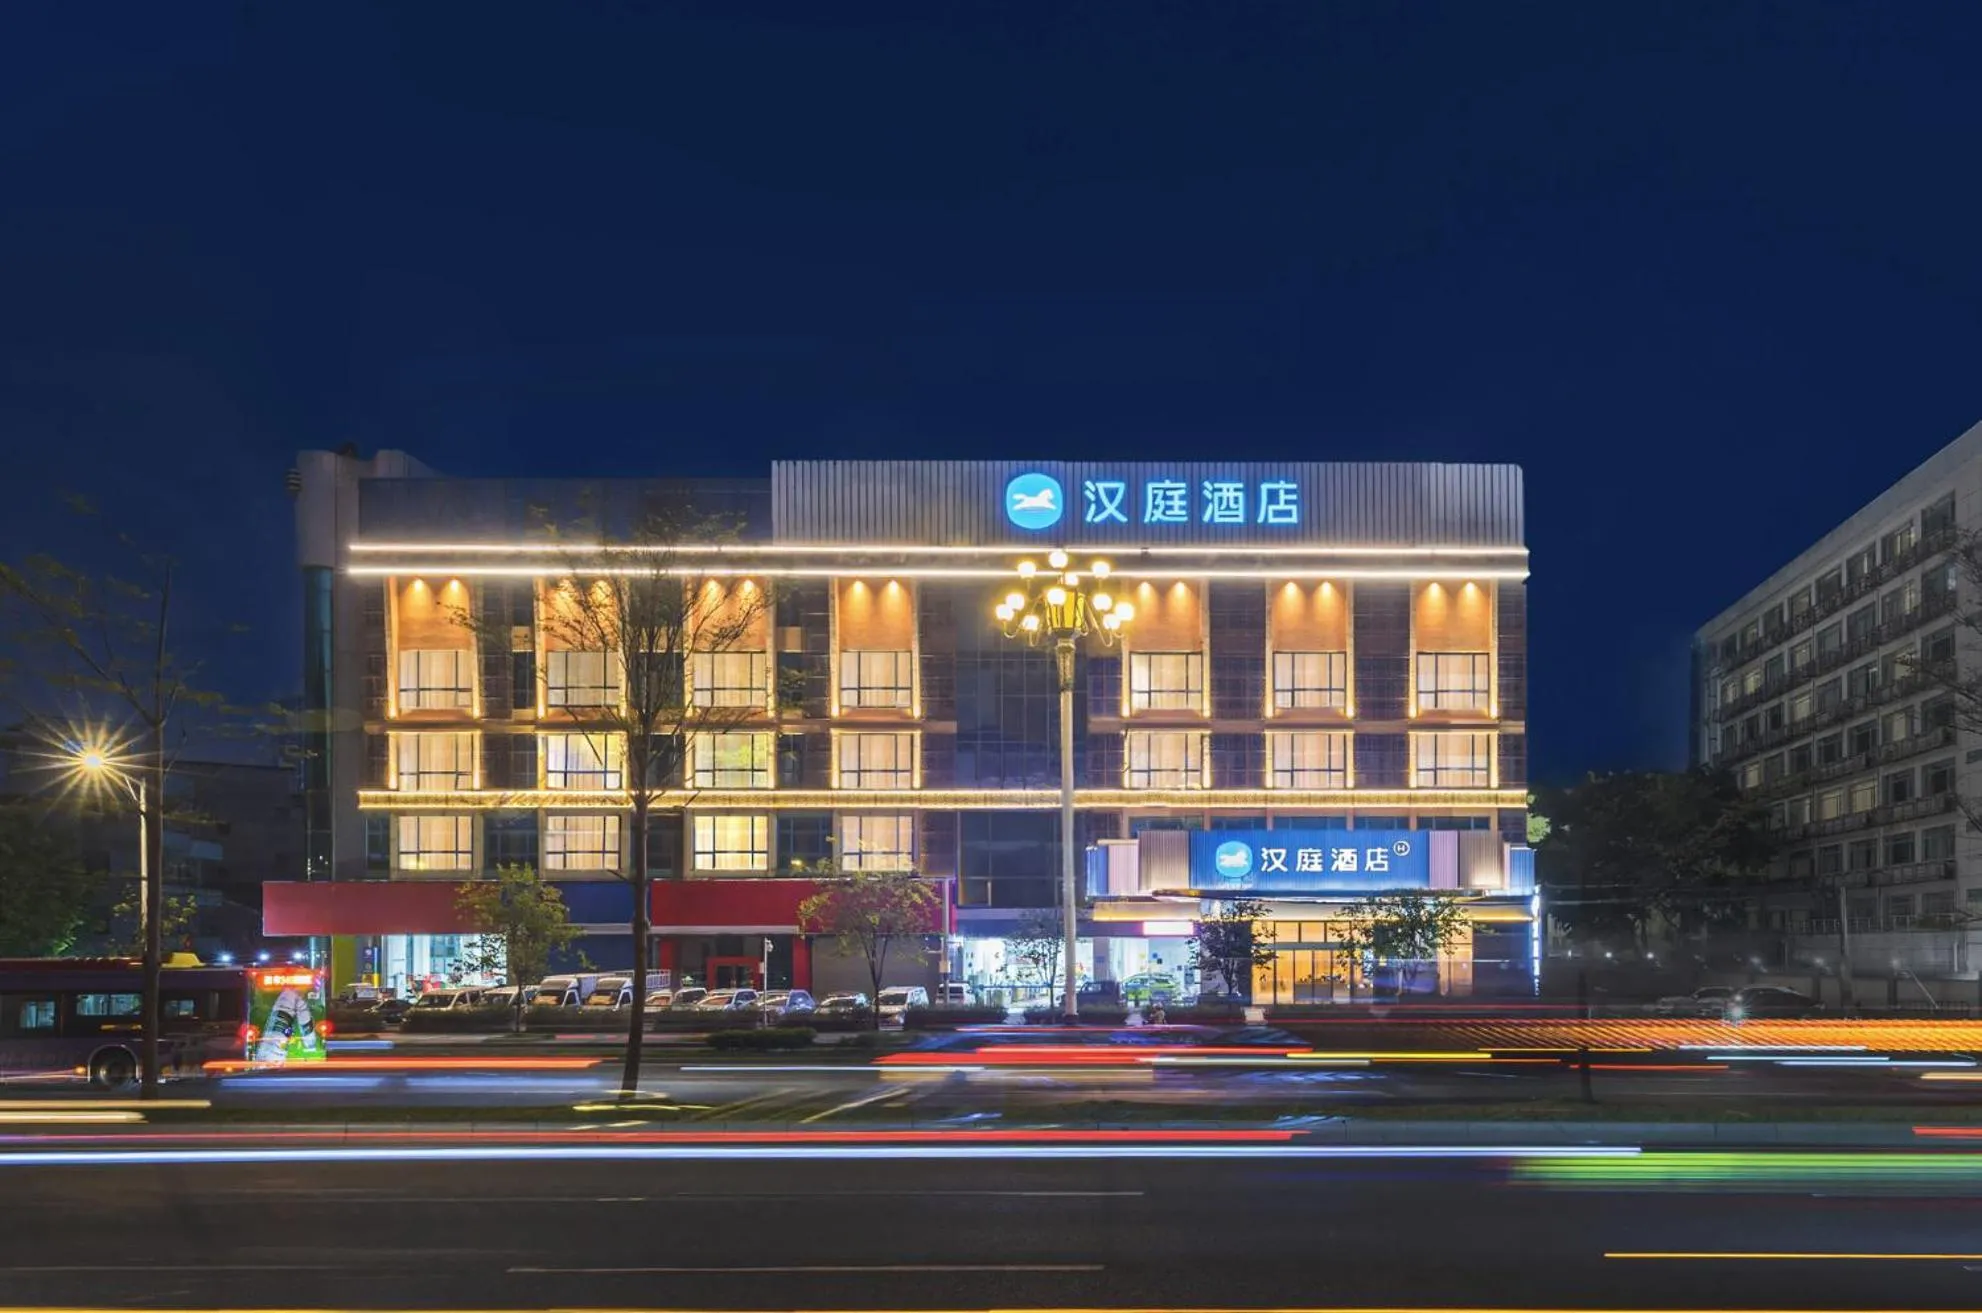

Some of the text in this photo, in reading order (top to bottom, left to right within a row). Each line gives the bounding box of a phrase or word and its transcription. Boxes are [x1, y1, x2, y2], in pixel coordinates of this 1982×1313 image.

[1084, 480, 1298, 524] 汉庭酒店
[1261, 847, 1389, 872] 汉庭酒店
